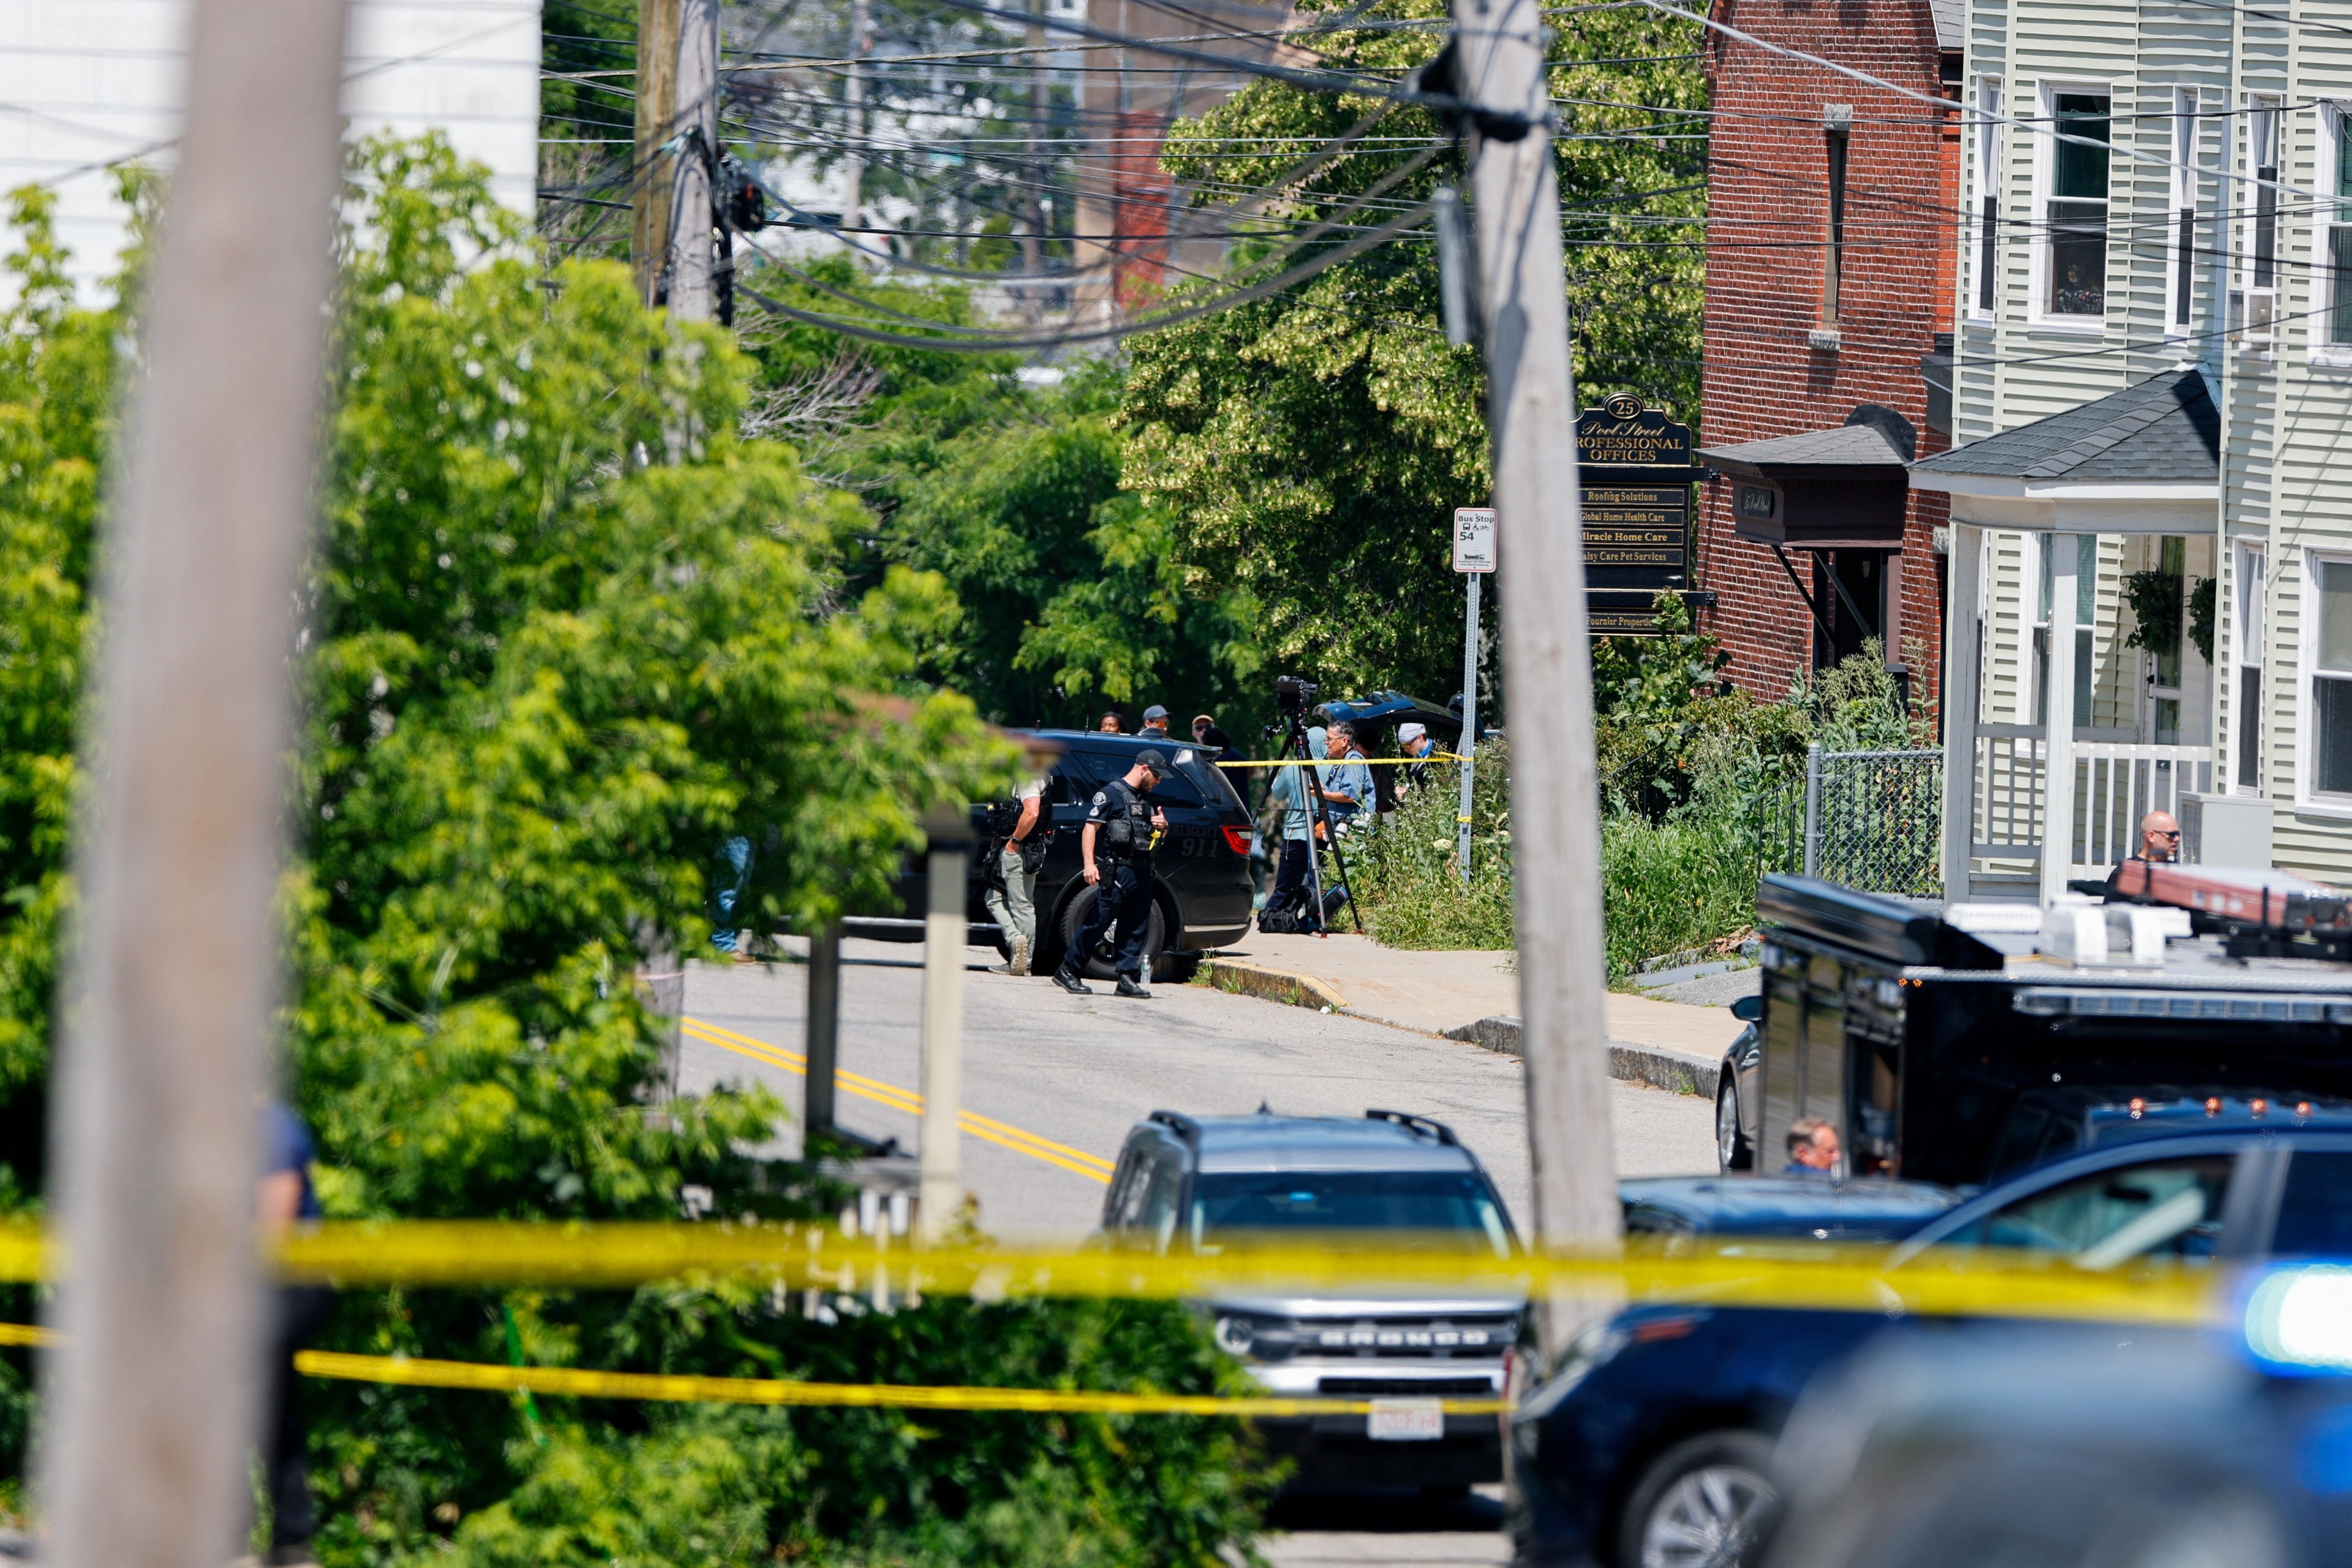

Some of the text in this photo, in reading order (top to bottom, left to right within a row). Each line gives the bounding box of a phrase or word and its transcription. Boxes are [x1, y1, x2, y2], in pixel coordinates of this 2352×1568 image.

[1616, 402, 1634, 415] 25
[1581, 421, 1665, 437] Pool Street
[1574, 437, 1683, 450] ROFESSIONAL
[1589, 449, 1656, 461] OFFICES
[1588, 491, 1657, 503] Roofing Solutions
[1579, 512, 1665, 521] Global Home Health Care
[1459, 532, 1474, 541] 54
[1615, 532, 1642, 541] Home
[1645, 532, 1668, 541] Care
[1600, 551, 1619, 560] Care
[1620, 552, 1632, 560] Pet
[1634, 552, 1666, 561] Services
[1618, 617, 1653, 628] Propertie
[1168, 824, 1218, 839] EMERGENCY
[1180, 838, 1219, 858] 911
